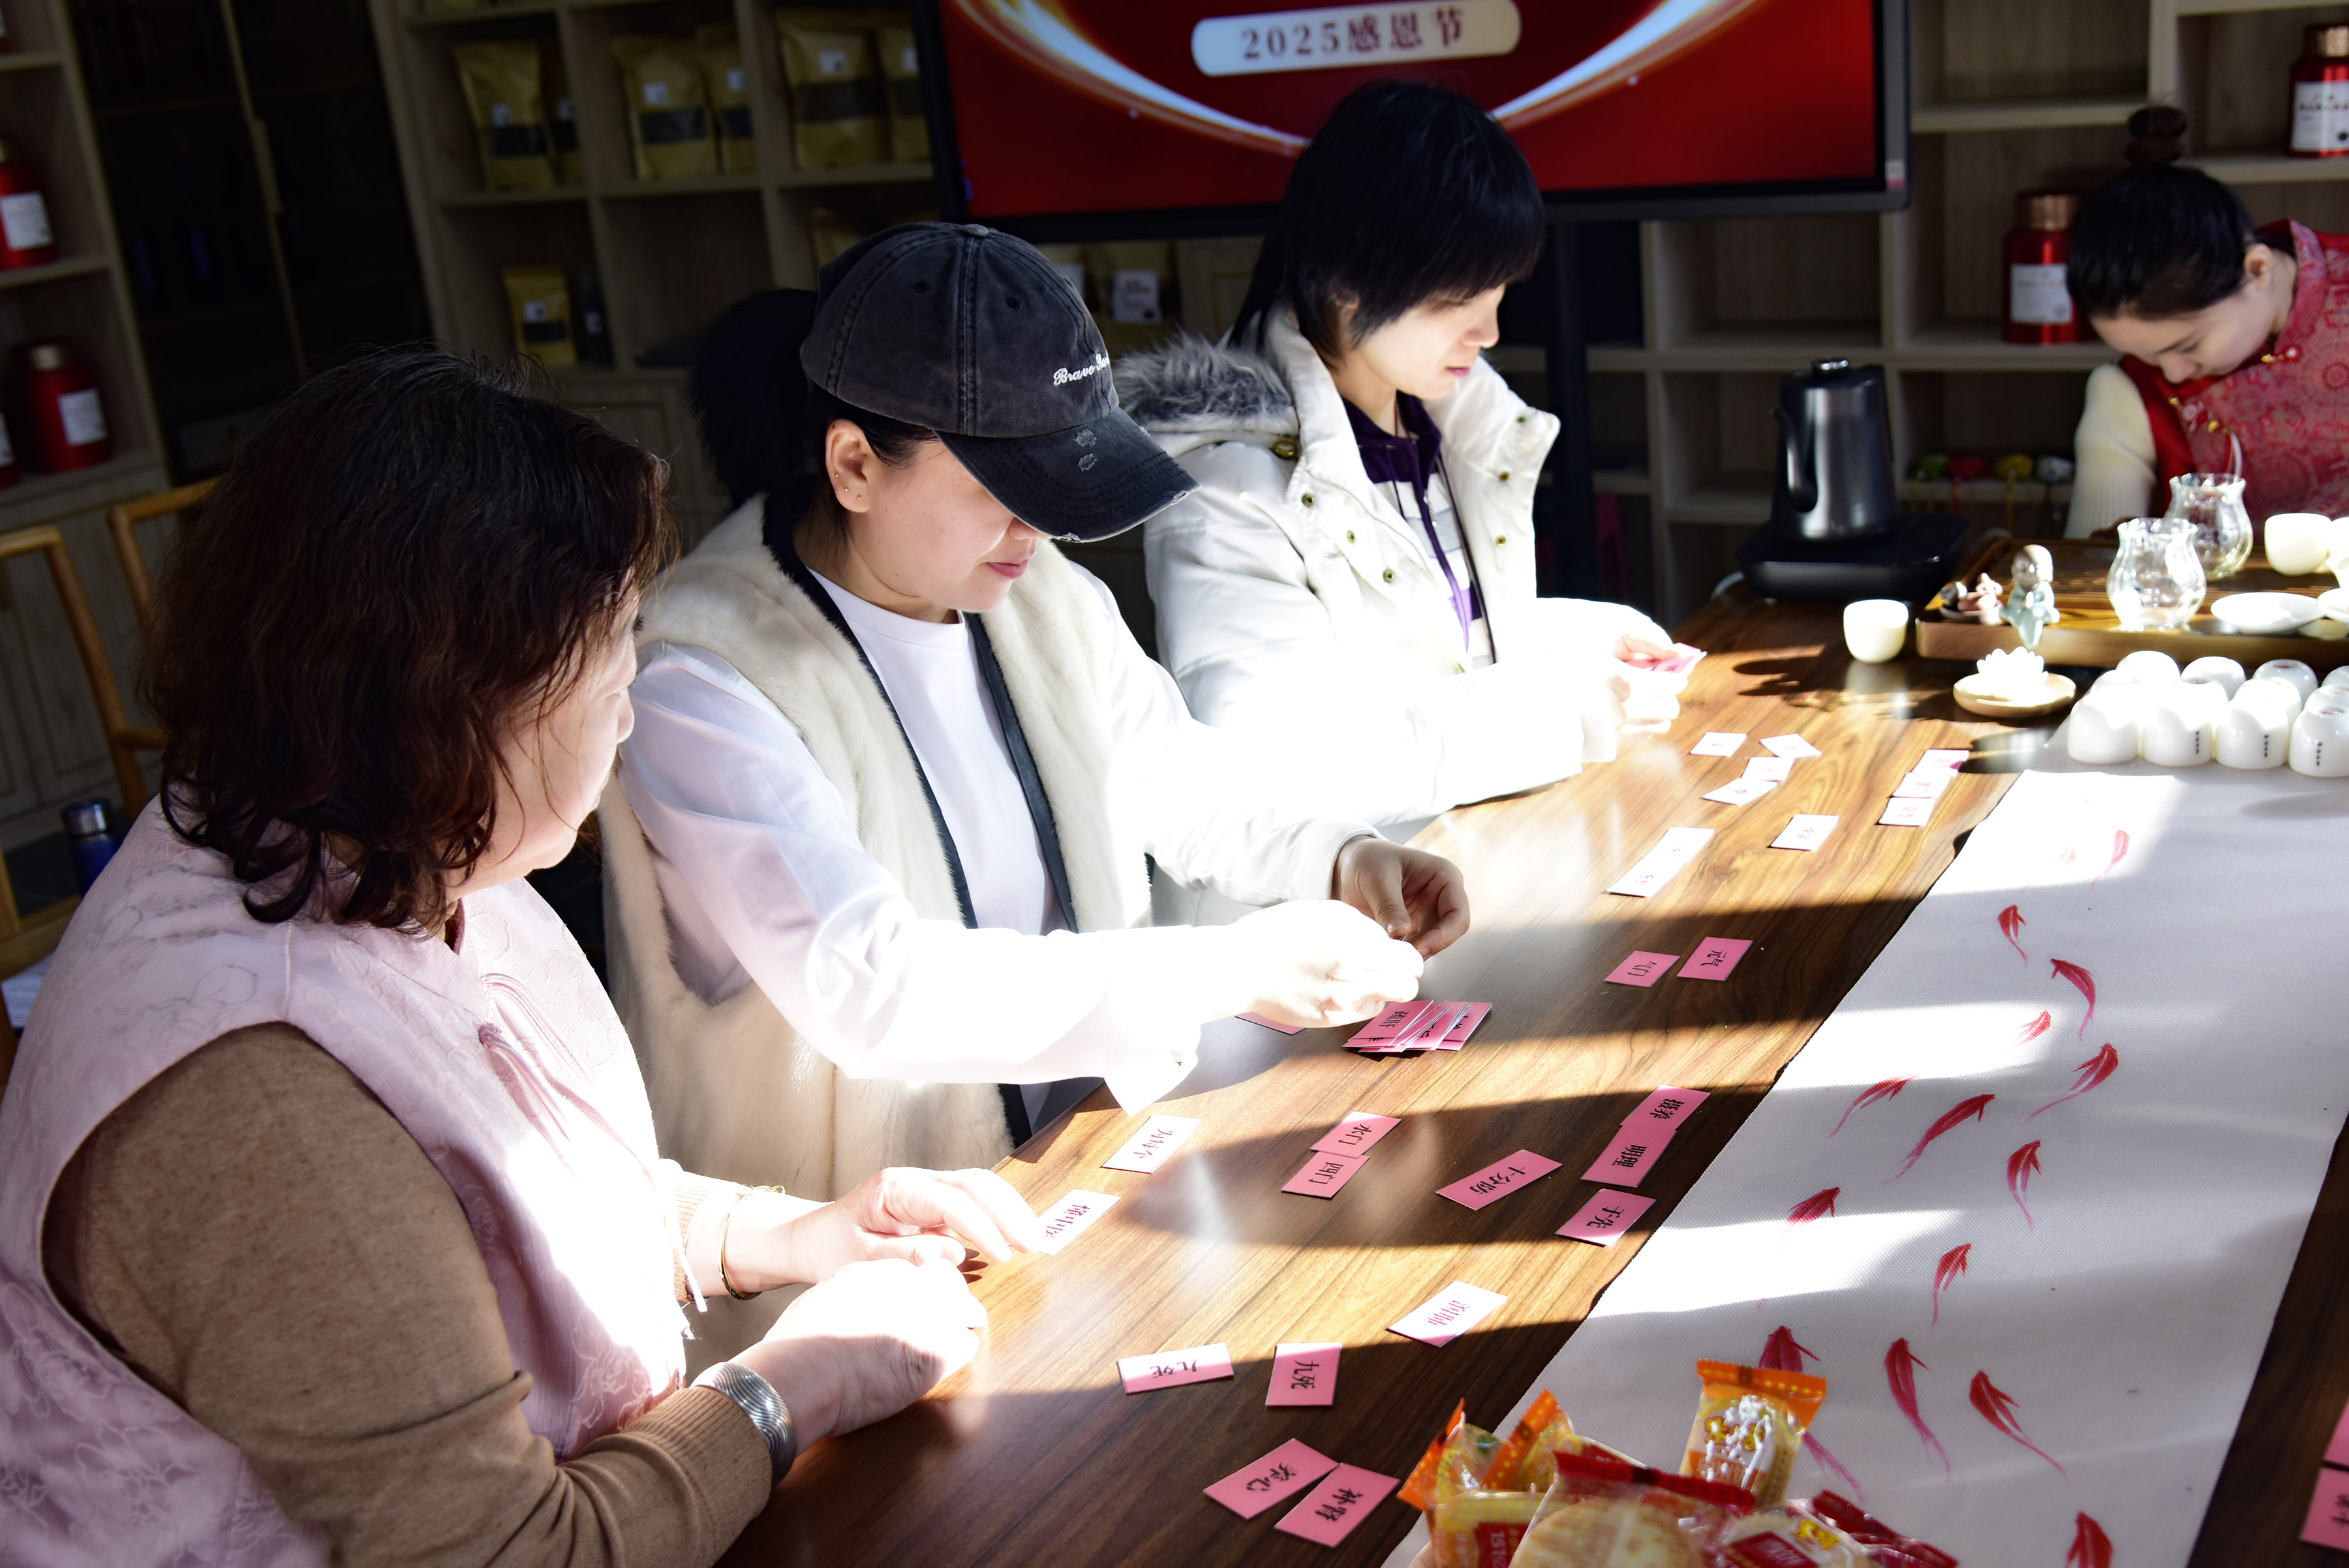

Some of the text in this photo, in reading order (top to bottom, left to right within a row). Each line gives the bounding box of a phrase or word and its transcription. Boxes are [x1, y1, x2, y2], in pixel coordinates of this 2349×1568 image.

[1240, 6, 1464, 59] 2025感恩节
[1052, 367, 1095, 385] Brave
[1627, 961, 1657, 977] 气门
[1700, 949, 1728, 967] 元气
[1378, 1011, 1410, 1028] 疏肝
[1650, 1098, 1685, 1120] 摄养
[1133, 1128, 1174, 1159] 为每个
[1338, 1123, 1372, 1146] 水门
[1611, 1145, 1648, 1168] 明理
[1308, 1161, 1344, 1185] 四门
[1469, 1166, 1527, 1195] 十分防
[1586, 1206, 1625, 1229] 于先
[1427, 1300, 1468, 1327] 润肺
[1150, 1359, 1199, 1379] 九死
[1290, 1360, 1320, 1389] 九死
[1246, 1462, 1298, 1492] 养心
[1314, 1488, 1364, 1522] 补肾
